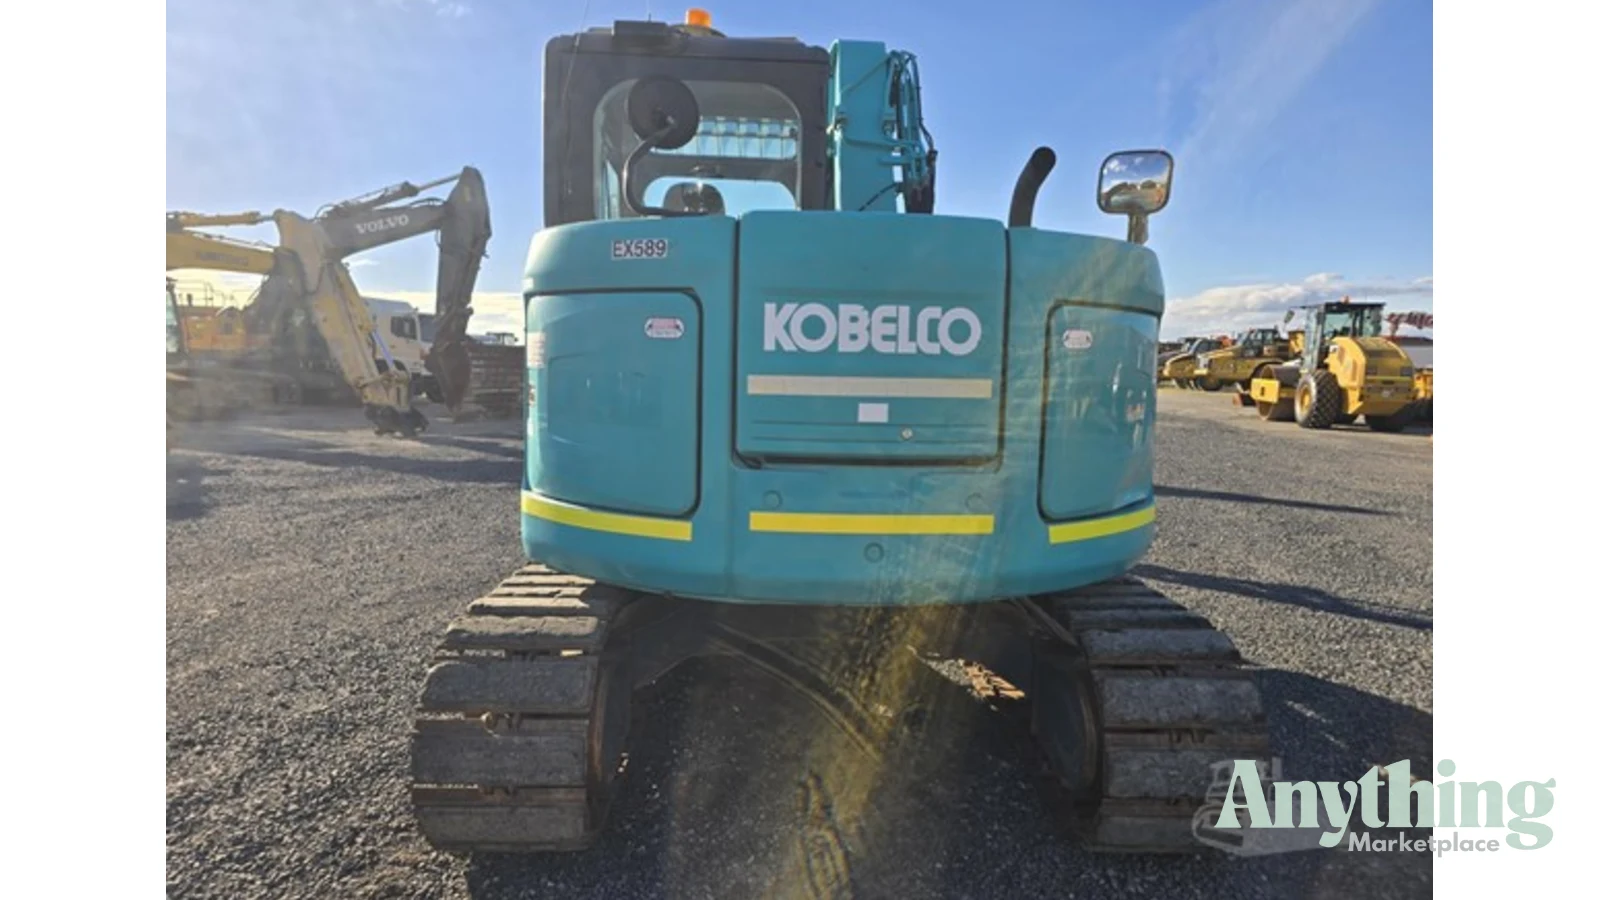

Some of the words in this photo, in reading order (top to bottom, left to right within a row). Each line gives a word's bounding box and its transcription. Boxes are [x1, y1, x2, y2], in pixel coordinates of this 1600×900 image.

[356, 214, 409, 234] VOLVO
[613, 239, 667, 257] EX589
[763, 302, 982, 356] KOBELCO
